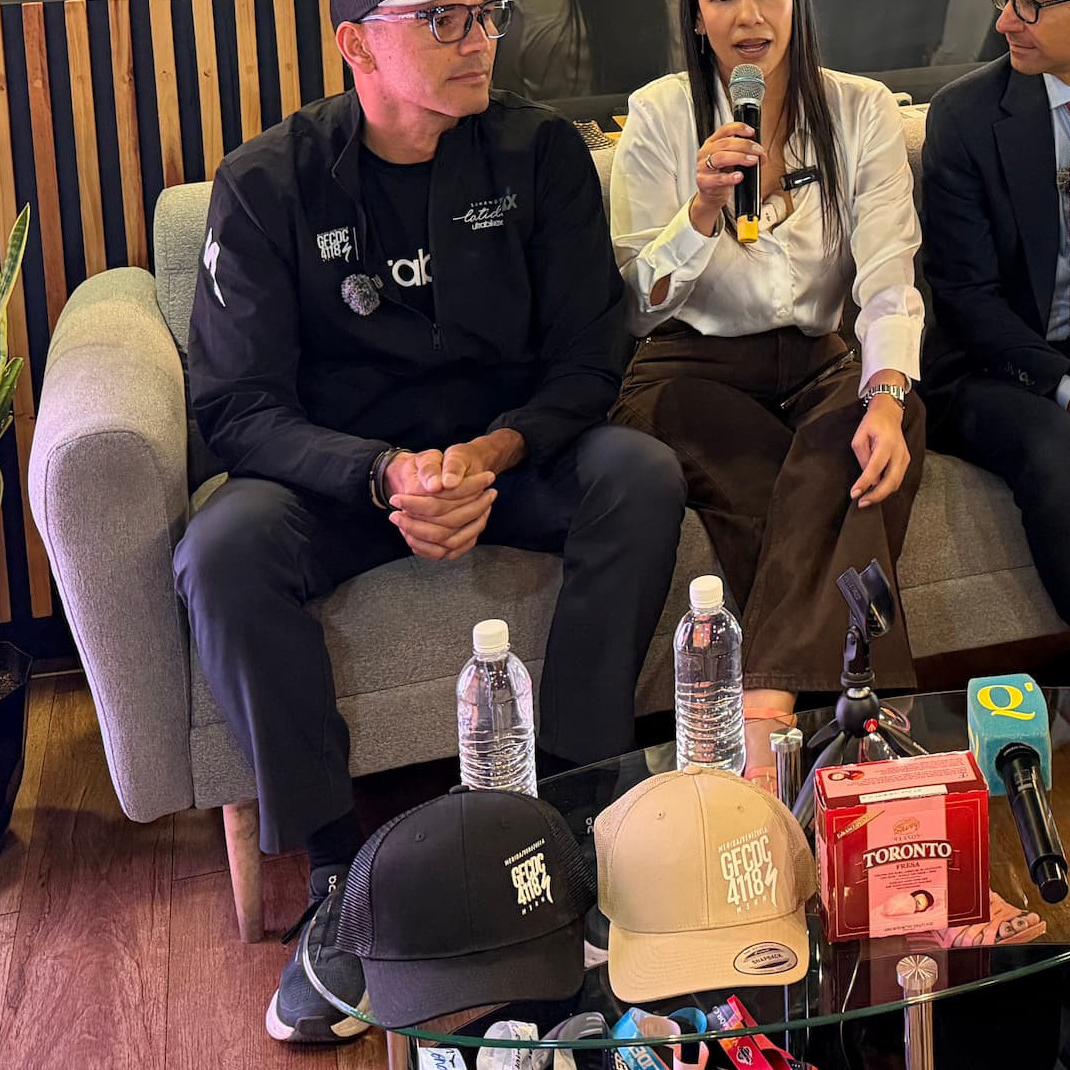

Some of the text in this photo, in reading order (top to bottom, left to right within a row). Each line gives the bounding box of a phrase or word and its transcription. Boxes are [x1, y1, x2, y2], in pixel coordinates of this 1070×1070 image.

[511, 853, 545, 888] GFCDC
[721, 835, 769, 880] GFCDC
[863, 842, 952, 868] TORONTO
[896, 861, 920, 870] FRESA
[518, 876, 542, 905] 4118
[727, 868, 765, 905] 4118
